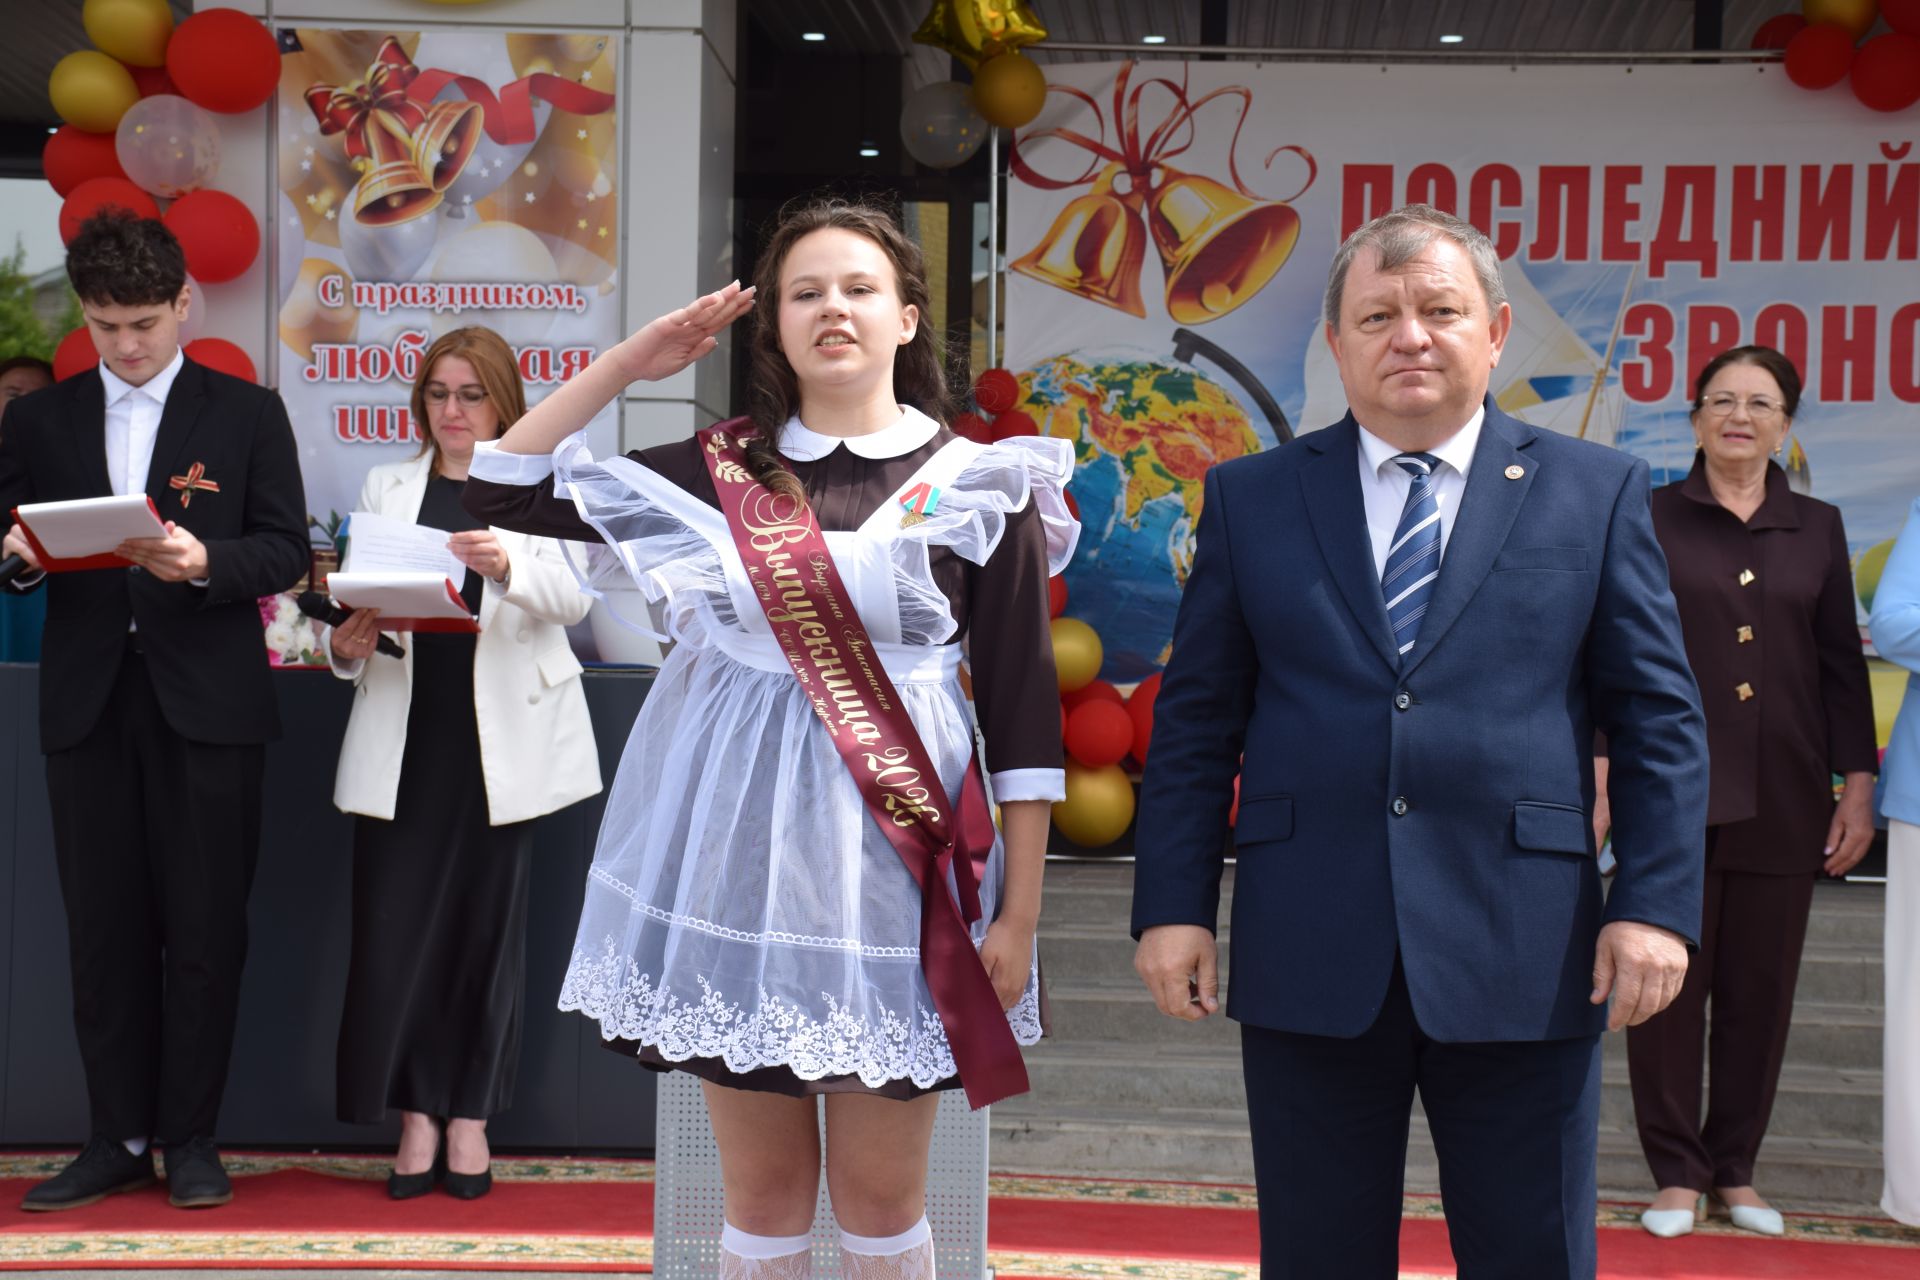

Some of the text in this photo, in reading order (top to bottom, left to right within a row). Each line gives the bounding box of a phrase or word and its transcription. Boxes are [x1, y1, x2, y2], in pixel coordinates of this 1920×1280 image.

[320, 277, 586, 313] С праздником,
[304, 330, 594, 383] любая
[740, 484, 881, 746] Выпускница
[840, 624, 891, 712] Анастасия
